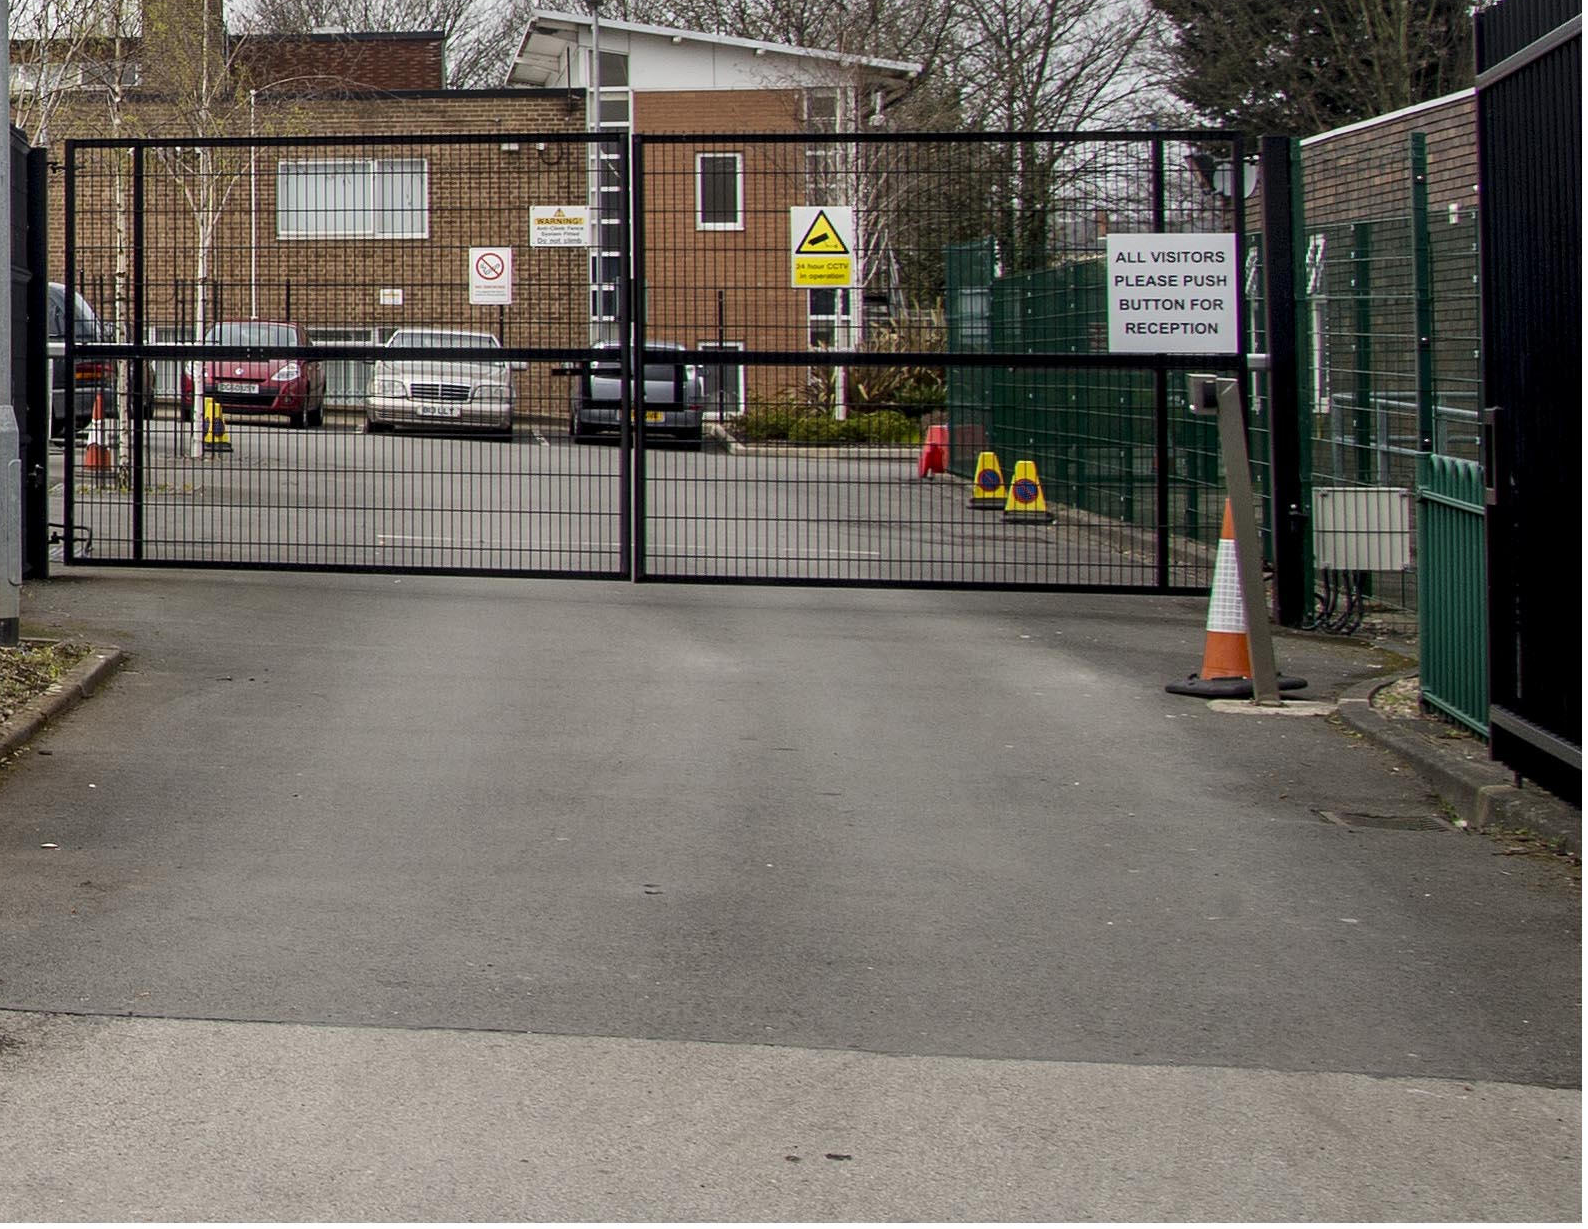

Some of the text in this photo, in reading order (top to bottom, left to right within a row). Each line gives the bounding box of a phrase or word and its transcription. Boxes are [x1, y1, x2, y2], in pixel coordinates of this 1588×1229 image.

[1115, 251, 1225, 263] ALL VISITORS
[1114, 275, 1227, 287] PLEASE PUSH
[1119, 299, 1223, 311] BUTTON FOR
[1125, 322, 1219, 334] RECEPTION
